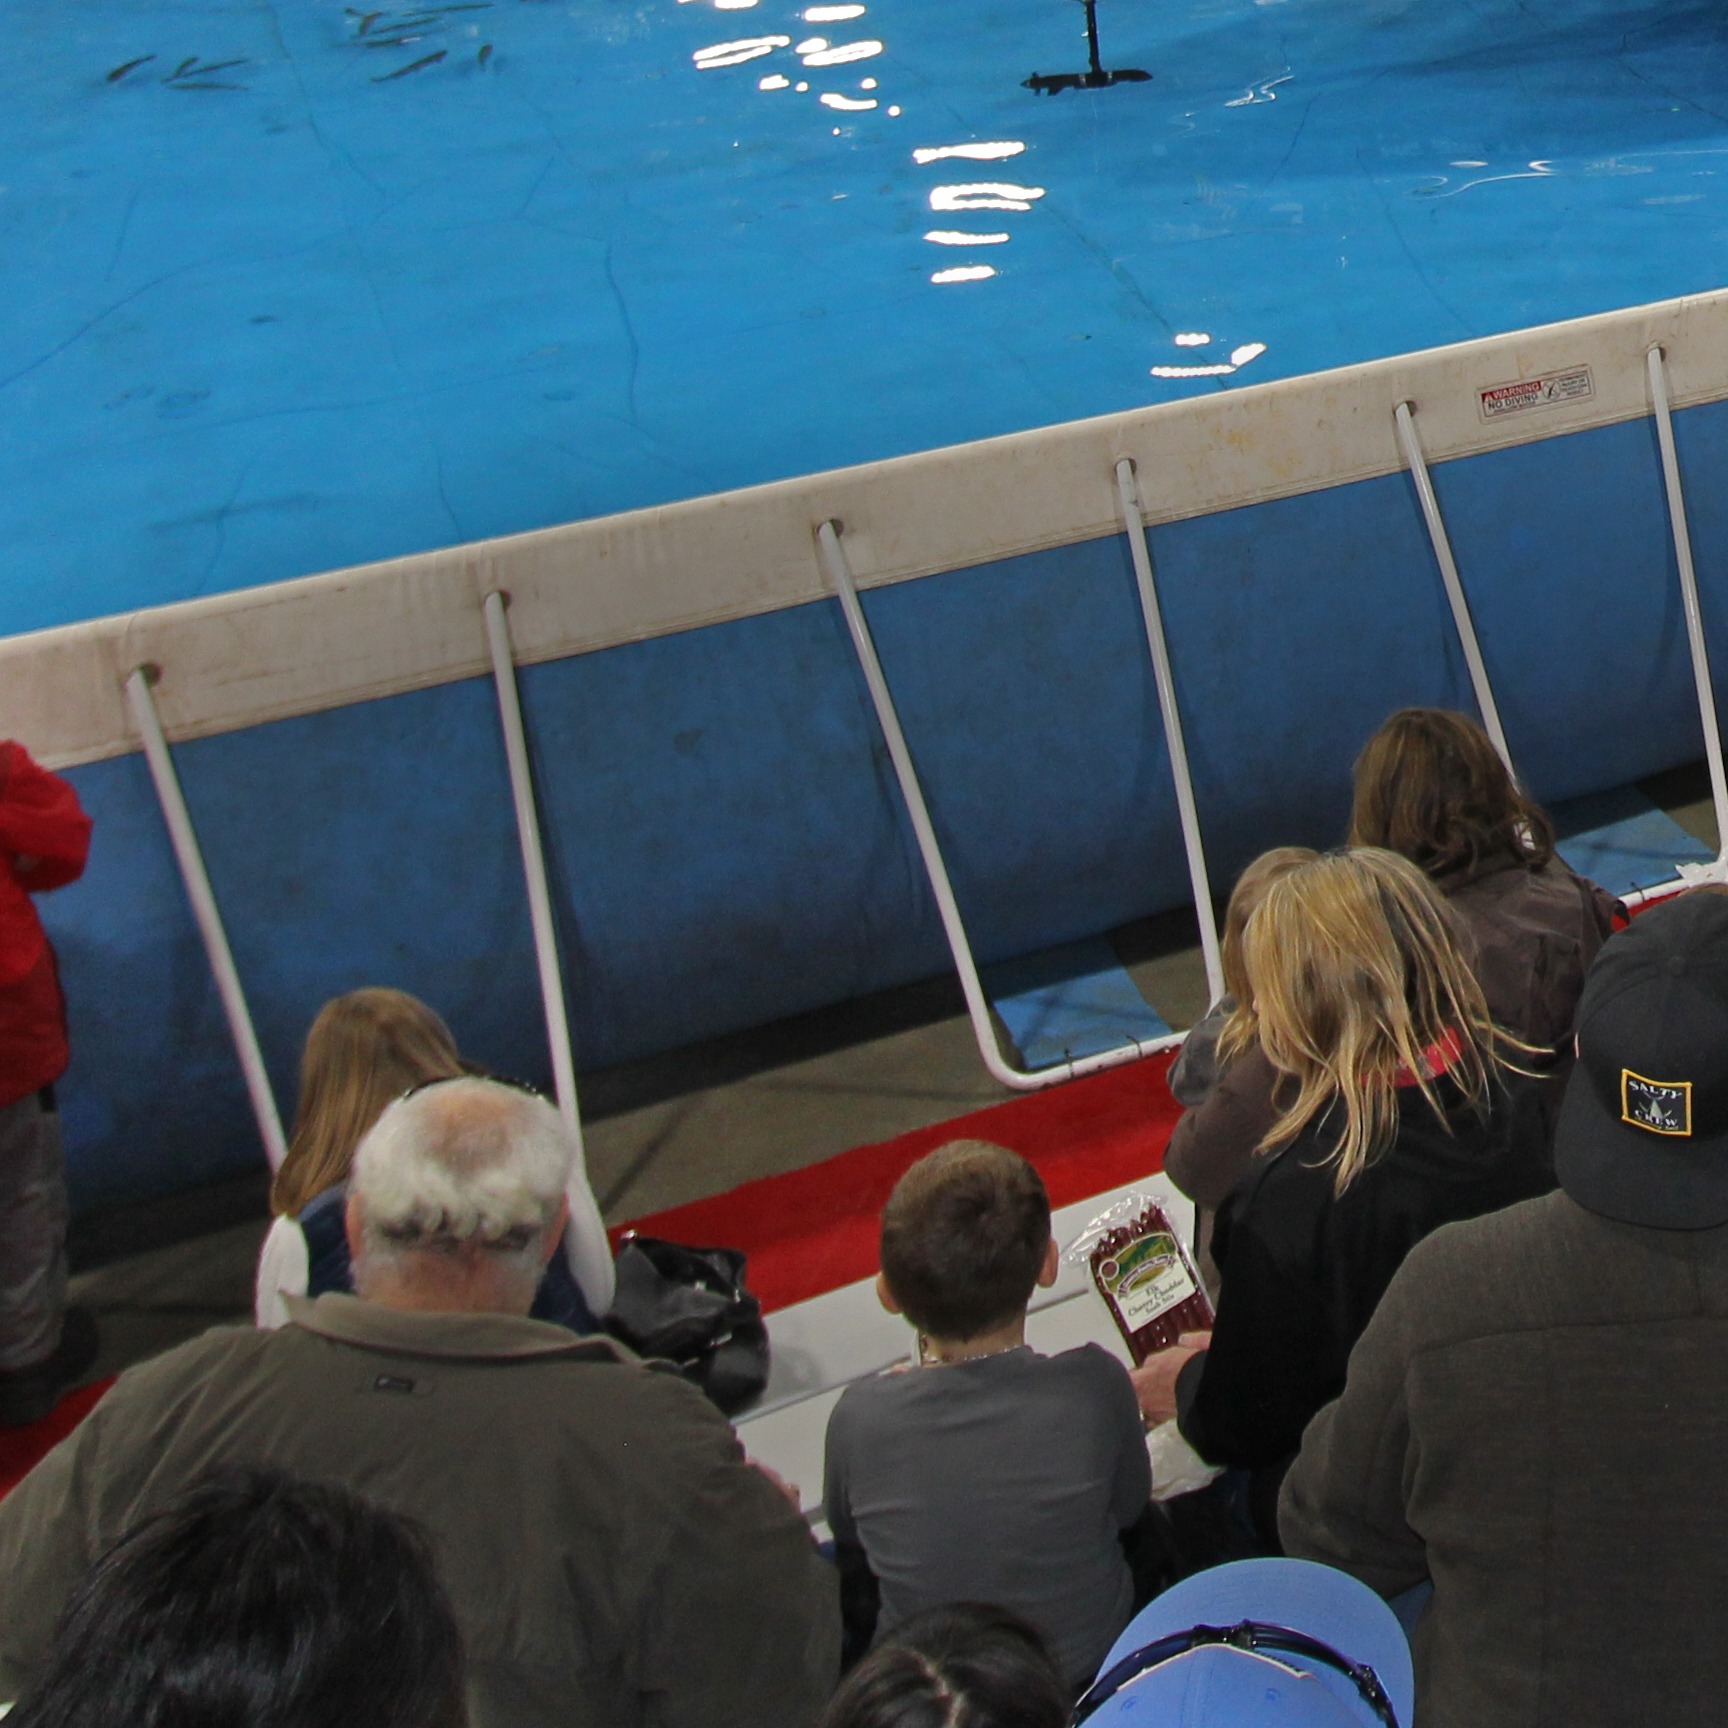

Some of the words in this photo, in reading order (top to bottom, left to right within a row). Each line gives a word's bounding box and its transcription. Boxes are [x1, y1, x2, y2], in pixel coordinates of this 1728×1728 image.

[1492, 381, 1541, 400] WARNING
[1488, 398, 1503, 411] NO
[1504, 391, 1539, 407] DIVING
[1628, 1080, 1683, 1100] SALTY
[1634, 1109, 1678, 1127] CREW
